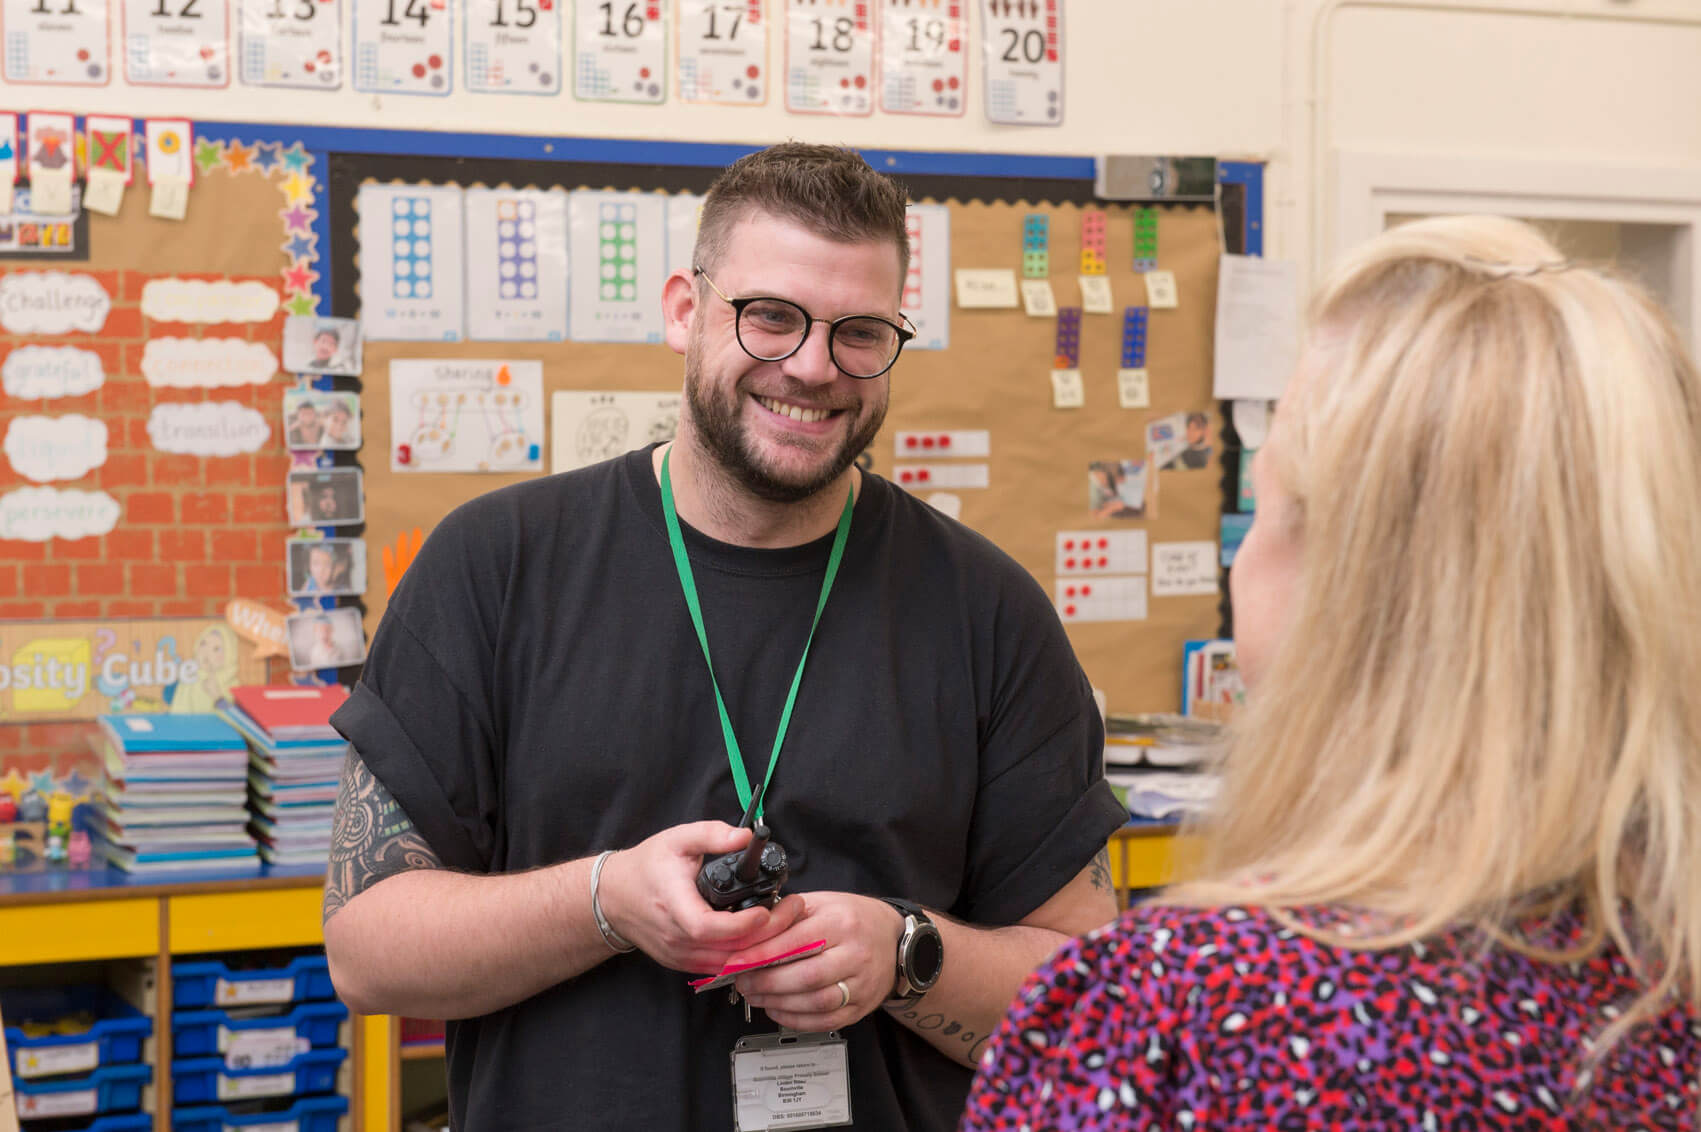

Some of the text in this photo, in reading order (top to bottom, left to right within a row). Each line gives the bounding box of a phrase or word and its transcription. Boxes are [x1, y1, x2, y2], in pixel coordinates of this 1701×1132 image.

[380, 0, 430, 28] 14
[489, 0, 537, 28] 15
[598, 2, 645, 38] 16
[702, 4, 746, 41] 17
[809, 17, 853, 52] 18
[906, 18, 945, 52] 19
[1000, 28, 1046, 63] 20
[102, 651, 198, 687] Cube
